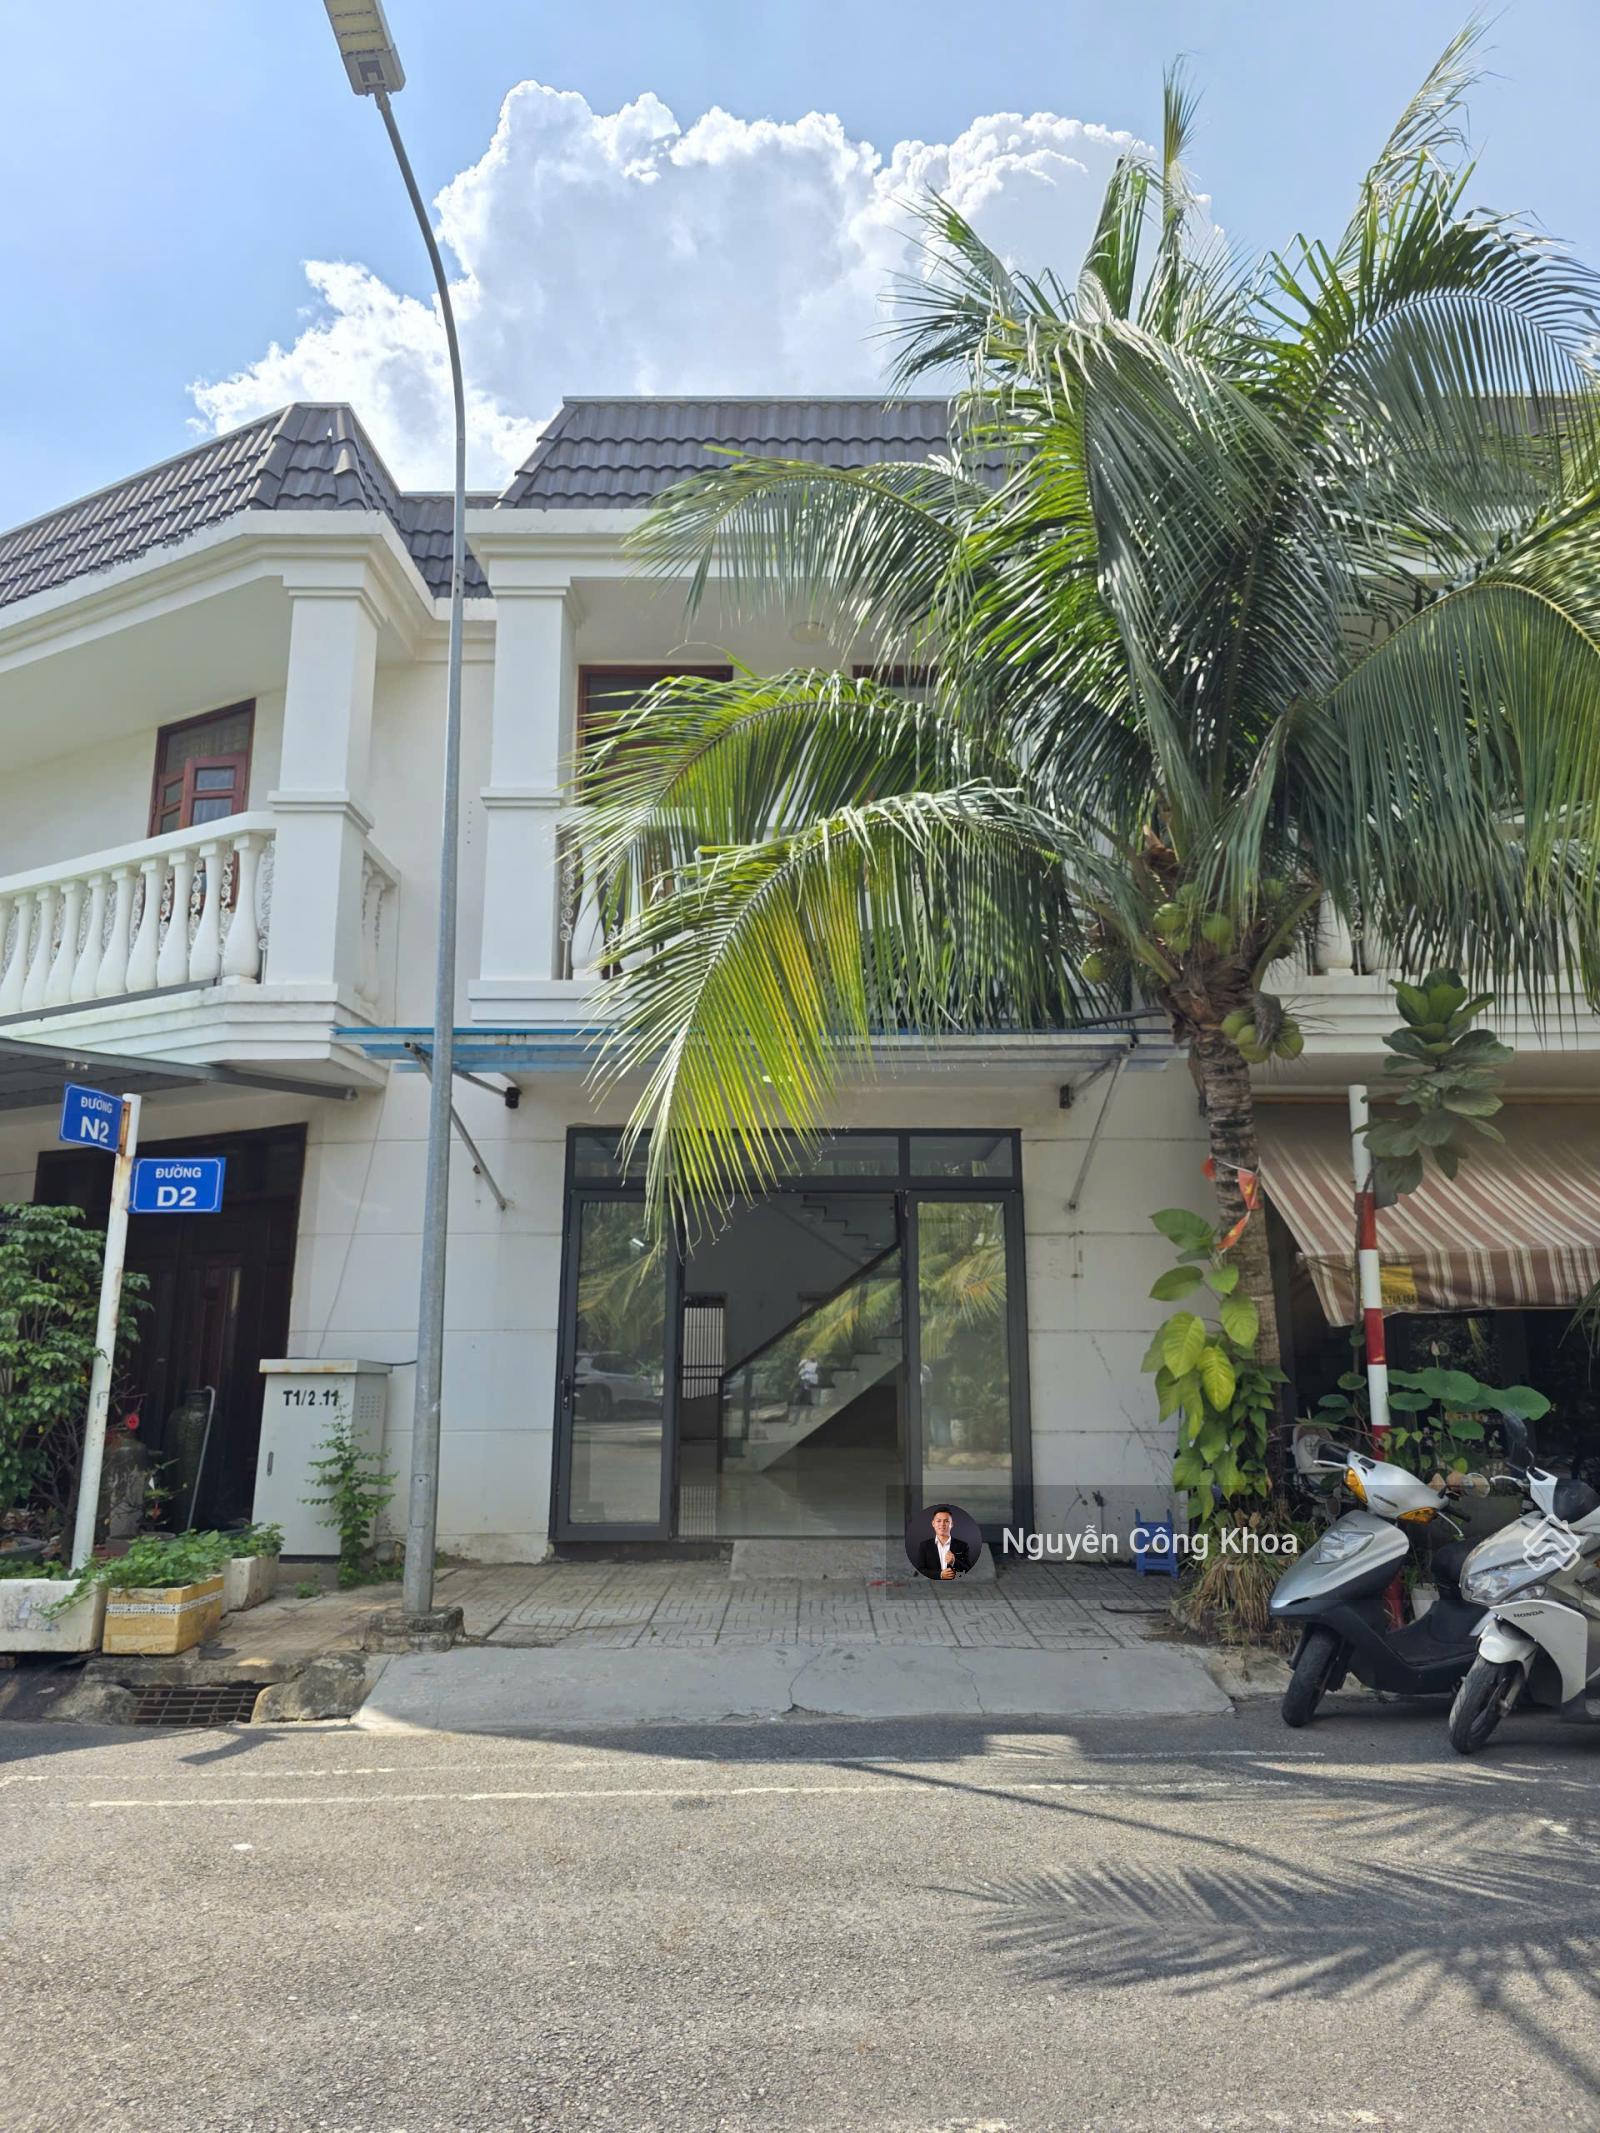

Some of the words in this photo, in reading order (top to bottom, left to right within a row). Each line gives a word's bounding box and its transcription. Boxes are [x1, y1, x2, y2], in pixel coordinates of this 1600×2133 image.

[80, 1096, 113, 1114] ĐƯỜNG
[80, 1116, 110, 1143] N2
[155, 1163, 202, 1179] ĐƯỜNG
[156, 1186, 197, 1207] D2
[1513, 1610, 1544, 1618] HONDA
